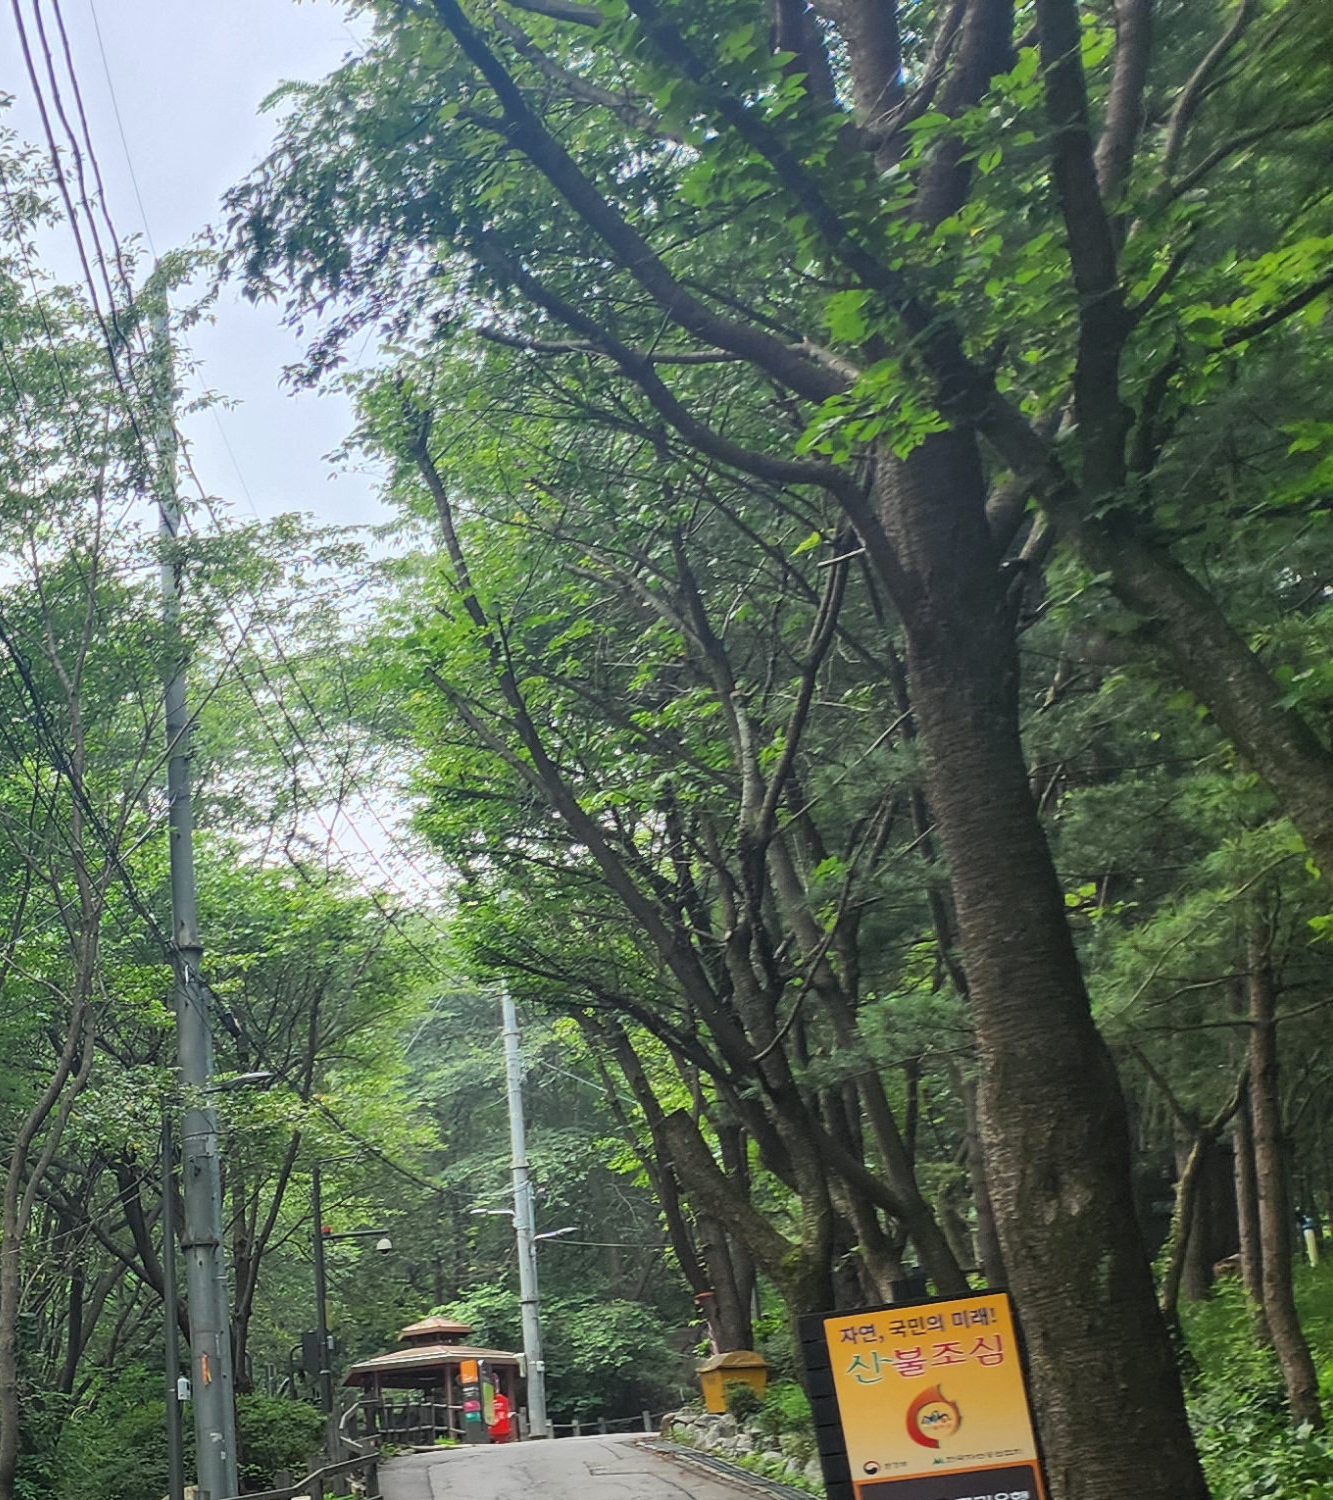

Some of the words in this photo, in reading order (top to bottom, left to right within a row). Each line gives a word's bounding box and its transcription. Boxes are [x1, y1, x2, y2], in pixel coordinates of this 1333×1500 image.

[840, 1323, 884, 1344] 자연,
[889, 1316, 945, 1337] 국민의
[951, 1307, 997, 1328] 미래!
[846, 1334, 1004, 1385] 산불조심
